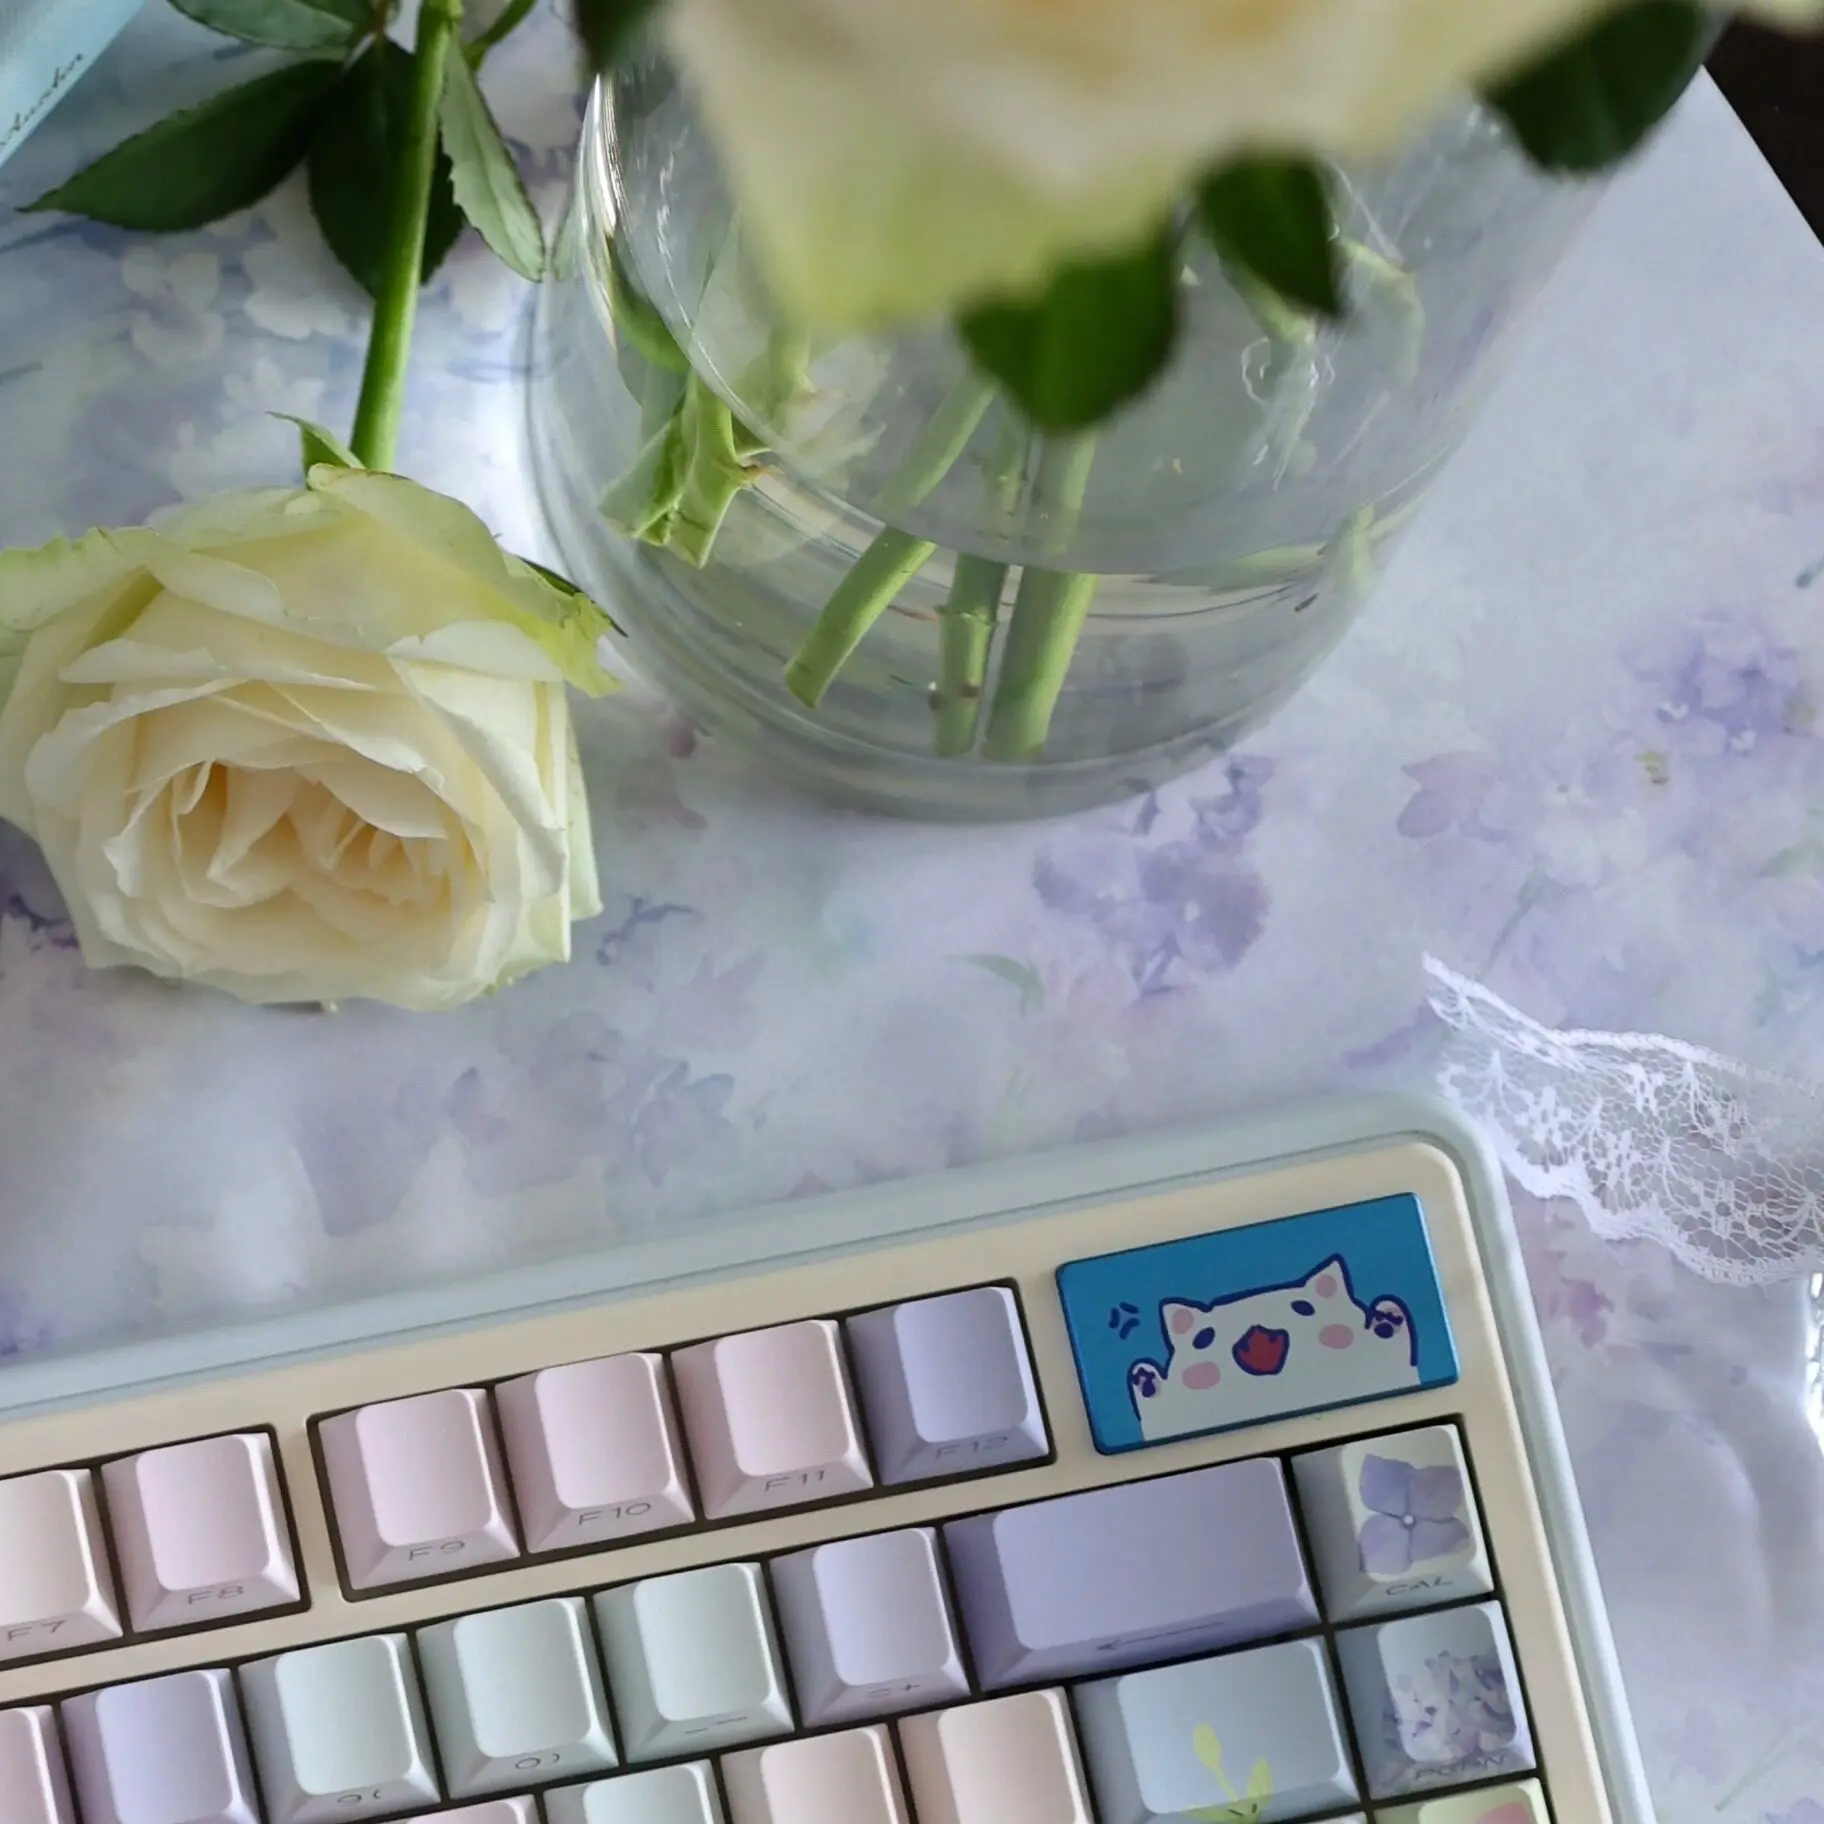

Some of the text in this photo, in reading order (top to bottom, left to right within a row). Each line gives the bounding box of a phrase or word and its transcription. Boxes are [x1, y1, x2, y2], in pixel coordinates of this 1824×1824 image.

[934, 1435, 1010, 1461] F12
[762, 1468, 827, 1493] F11
[576, 1499, 652, 1526] F10
[406, 1539, 468, 1562] F9
[186, 1585, 244, 1606] F8
[5, 1618, 67, 1642] F7
